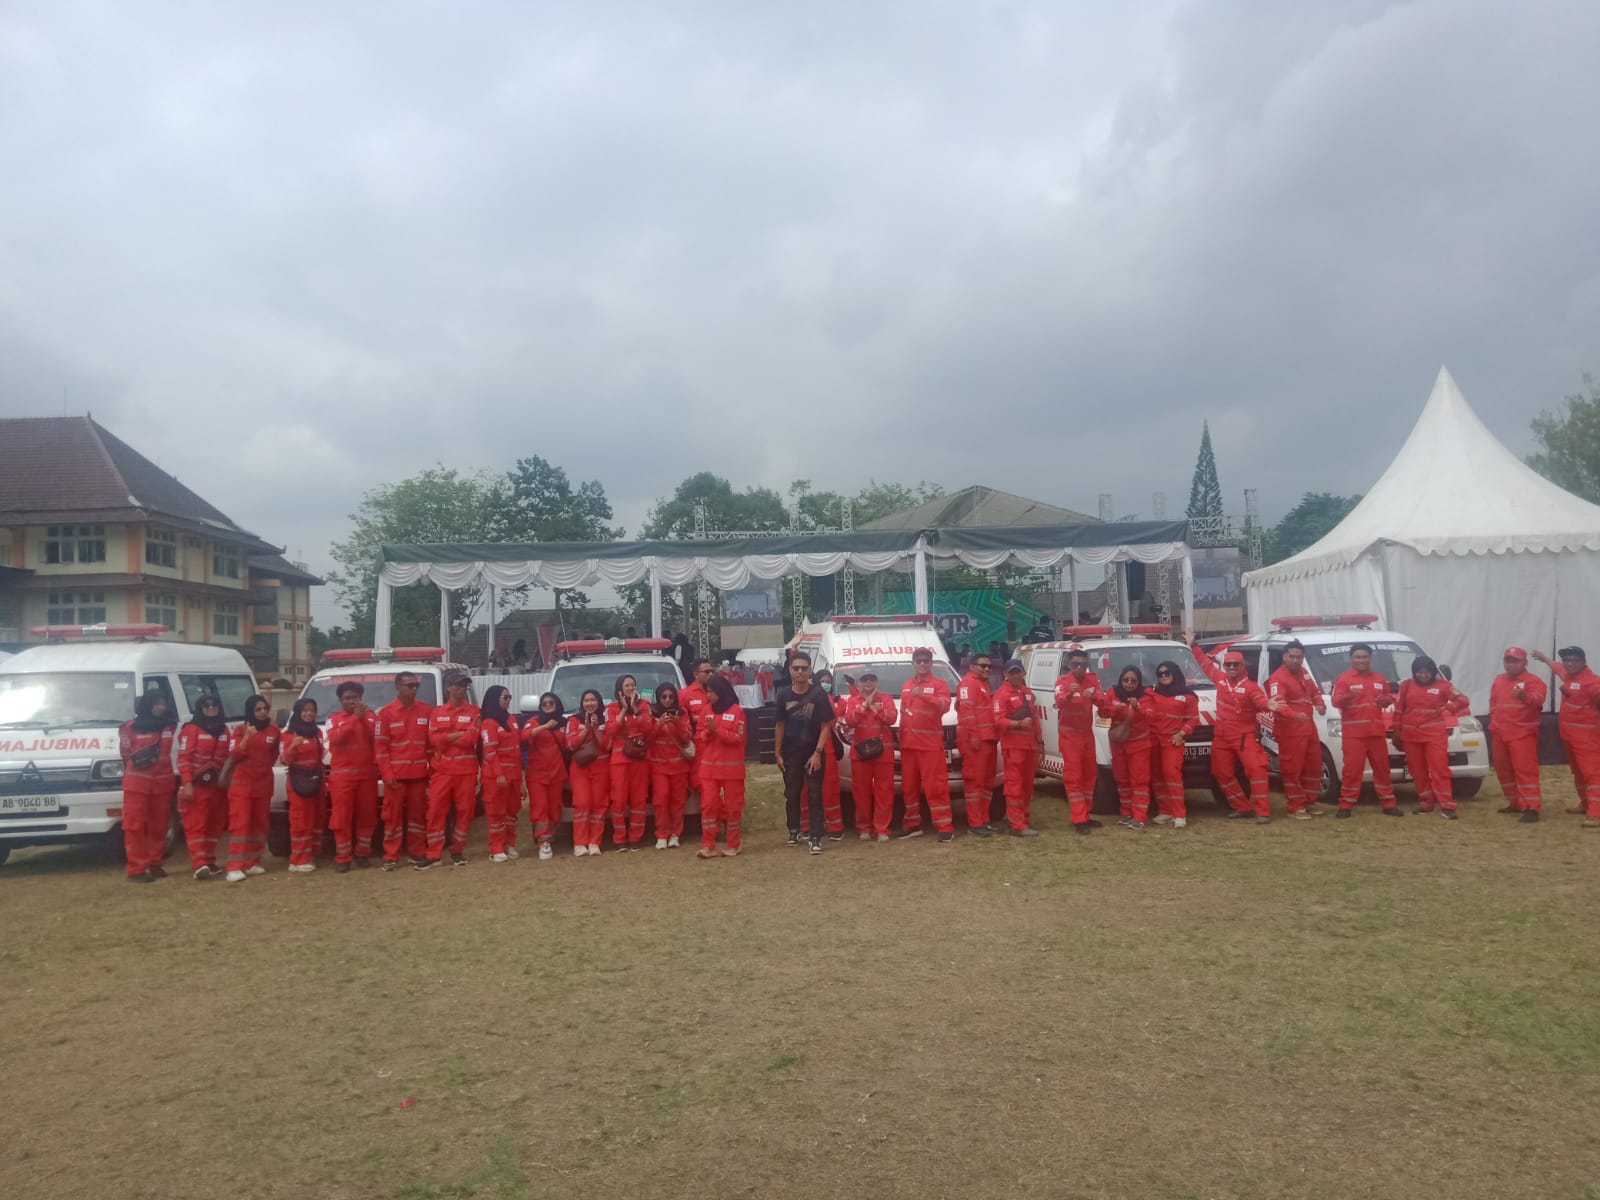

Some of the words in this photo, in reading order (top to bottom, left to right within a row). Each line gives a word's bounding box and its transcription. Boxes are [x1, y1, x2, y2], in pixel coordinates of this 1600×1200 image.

[2, 799, 14, 808] AB
[17, 797, 41, 807] 9040
[44, 797, 56, 806] BB
